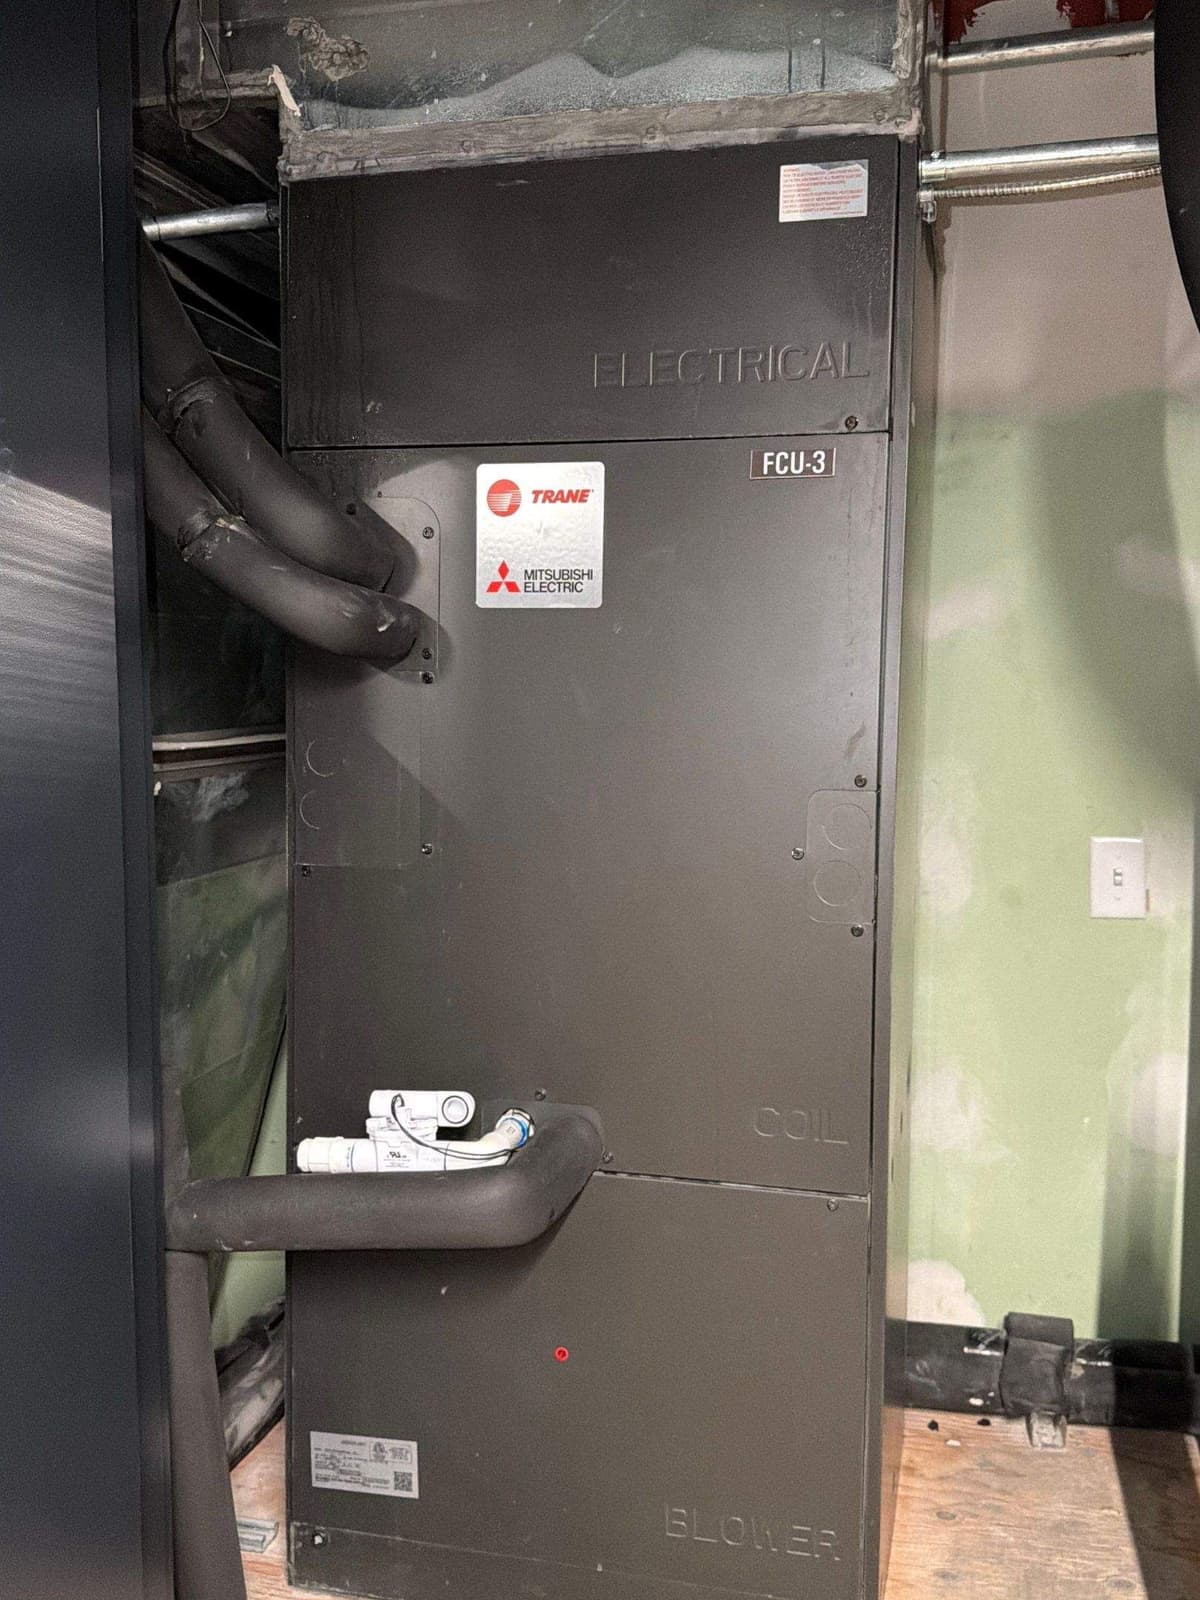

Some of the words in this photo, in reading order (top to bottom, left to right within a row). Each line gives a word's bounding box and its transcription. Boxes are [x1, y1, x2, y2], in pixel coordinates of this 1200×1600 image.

[593, 340, 871, 389] ELECTRICAL
[762, 450, 826, 476] FCU-3
[531, 488, 592, 505] TRANE
[523, 568, 594, 581] MITSUBISHI
[523, 580, 584, 594] ELECTRIC
[753, 1106, 849, 1146] COIL
[664, 1502, 841, 1562] BLOWER
